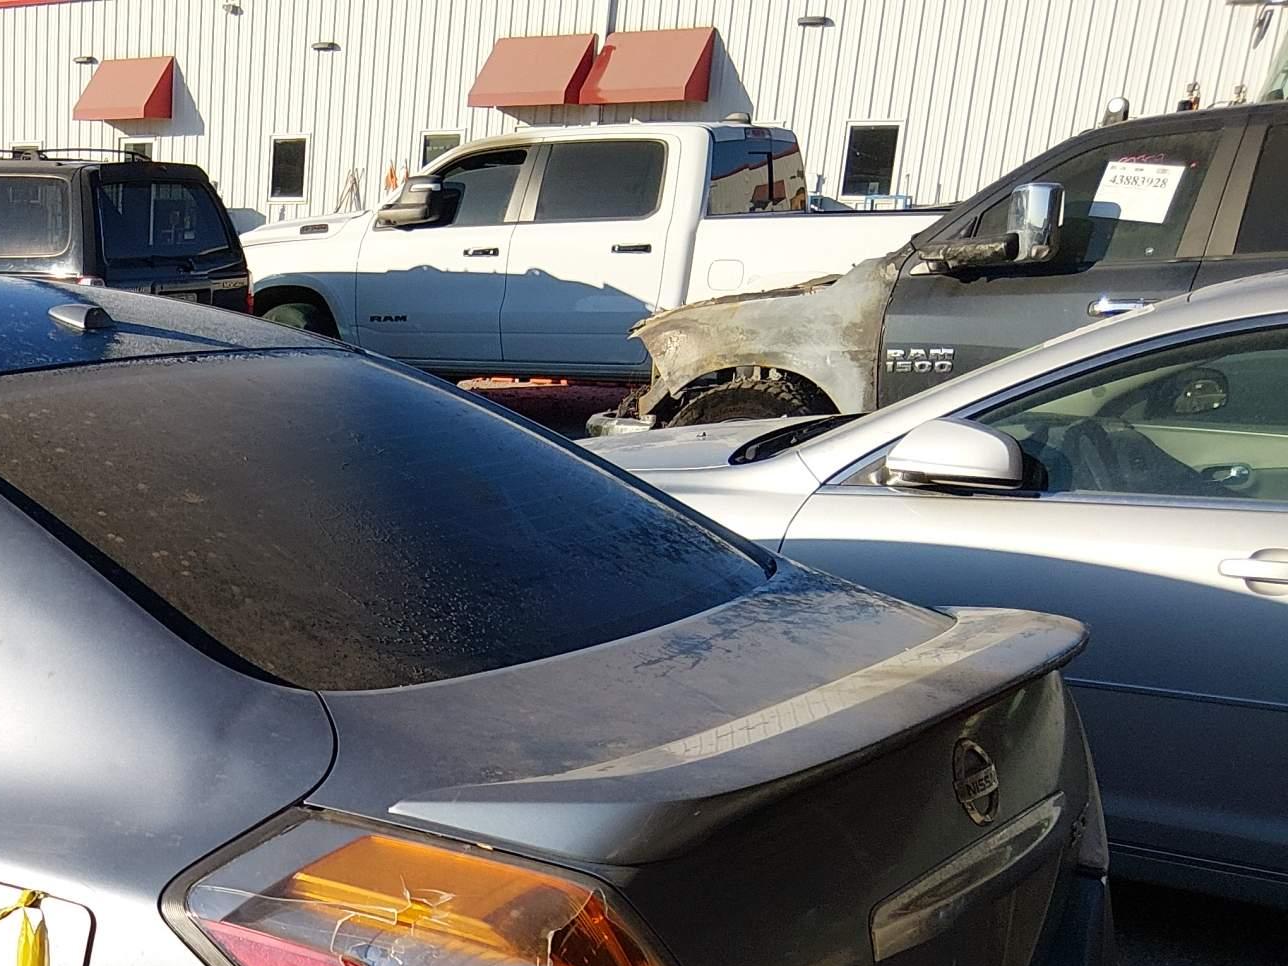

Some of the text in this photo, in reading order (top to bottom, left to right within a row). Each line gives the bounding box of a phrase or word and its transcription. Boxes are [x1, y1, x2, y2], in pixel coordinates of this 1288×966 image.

[1108, 174, 1170, 189] 43883928
[368, 315, 408, 323] RAM
[886, 347, 955, 361] RAM
[886, 361, 954, 374] 1500
